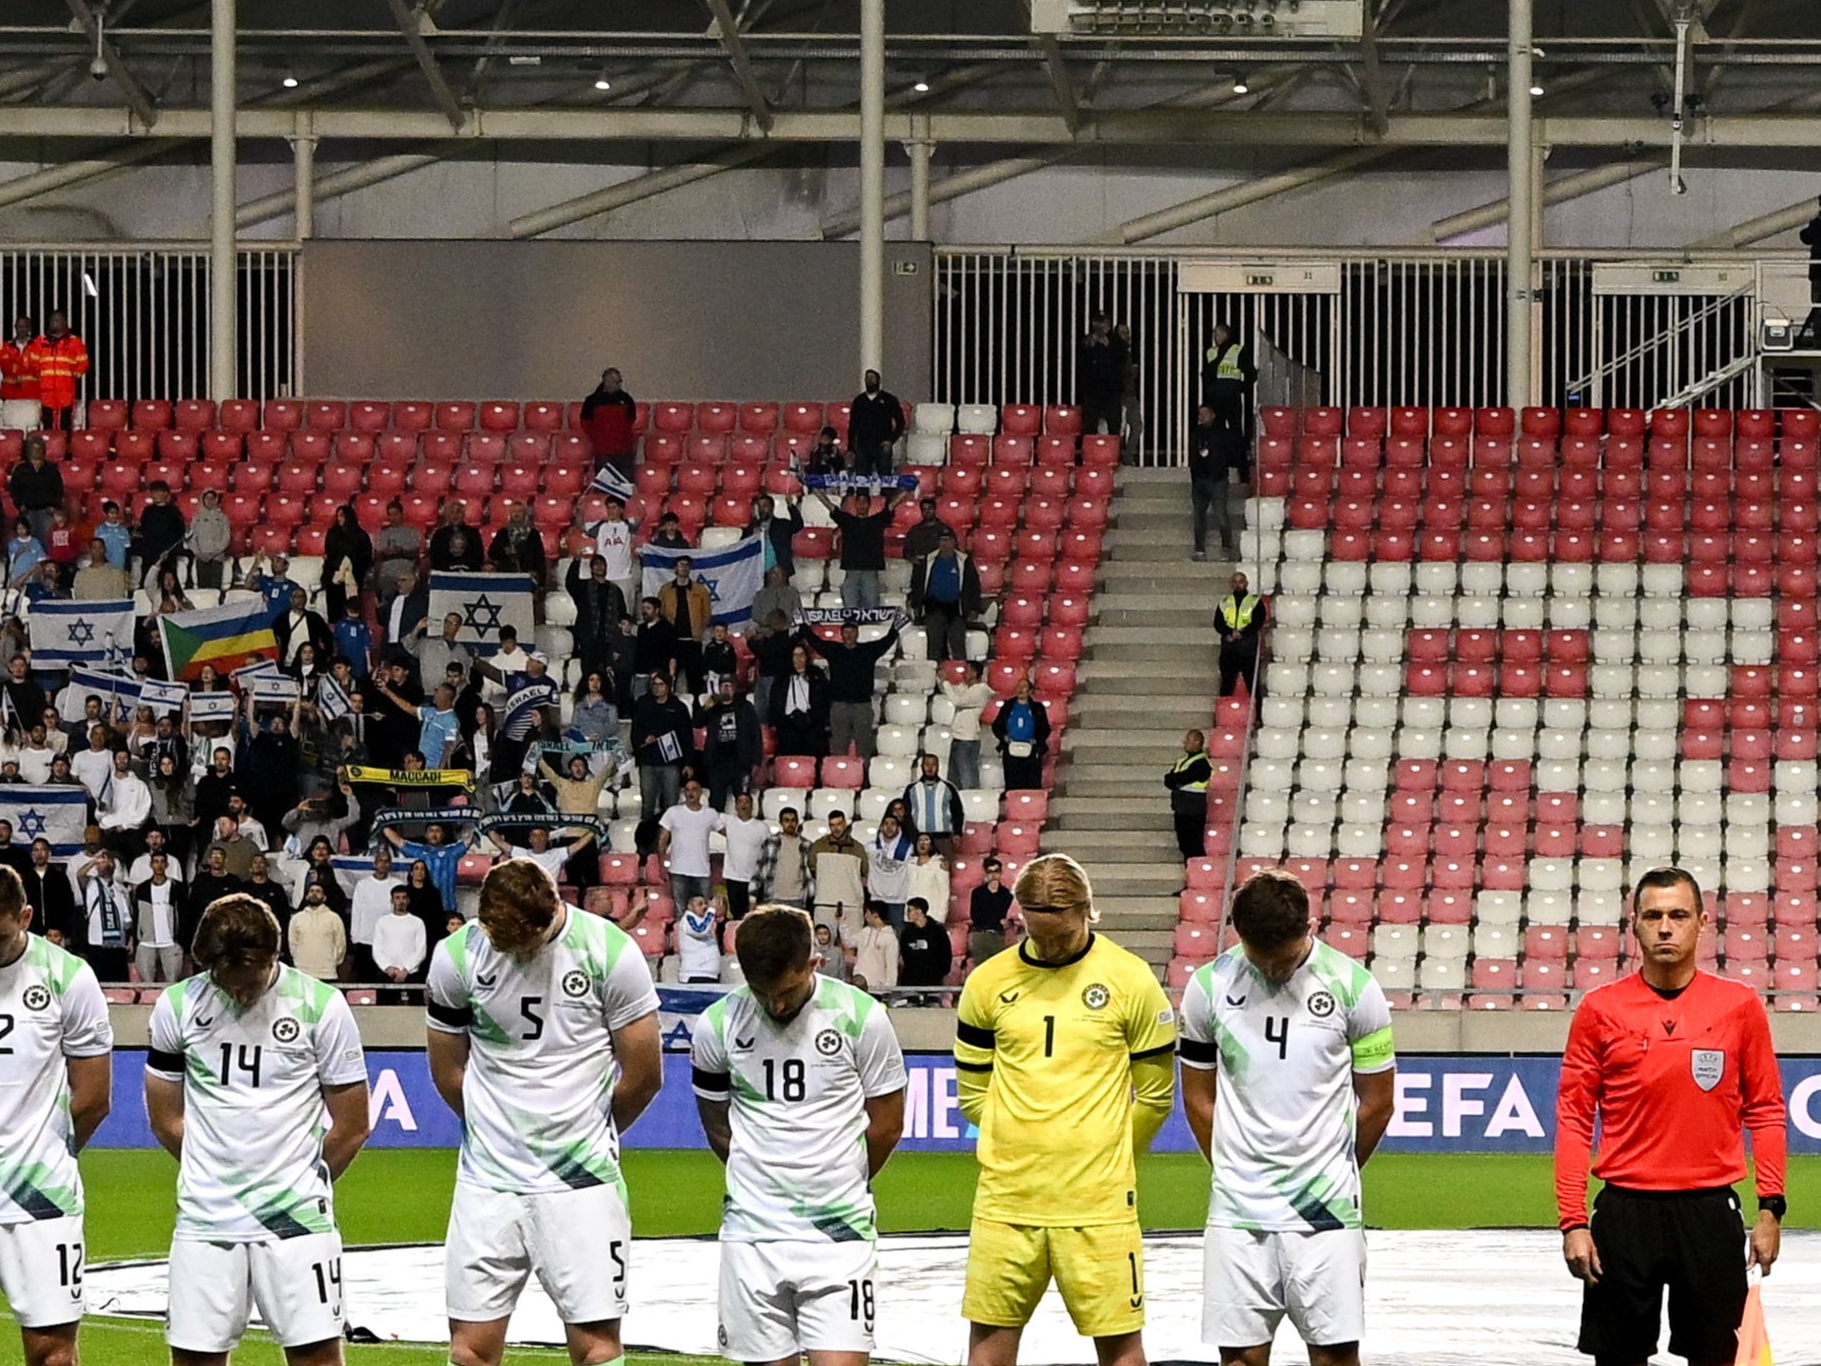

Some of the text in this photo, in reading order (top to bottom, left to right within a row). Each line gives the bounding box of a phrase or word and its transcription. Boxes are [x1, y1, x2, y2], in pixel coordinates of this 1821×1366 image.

[807, 610, 843, 622] ISRAEL
[507, 686, 545, 712] ISRAEL
[520, 996, 544, 1040] 5
[1043, 1015, 1055, 1058] 1
[1264, 1016, 1289, 1060] 4
[220, 1042, 262, 1088] 14
[762, 1059, 806, 1101] 18
[1386, 1072, 1546, 1137] EFA
[55, 1243, 82, 1286] 12
[312, 1257, 342, 1304] 14
[609, 1240, 625, 1282] 5
[1128, 1251, 1139, 1294] 1
[848, 1279, 875, 1320] 18
